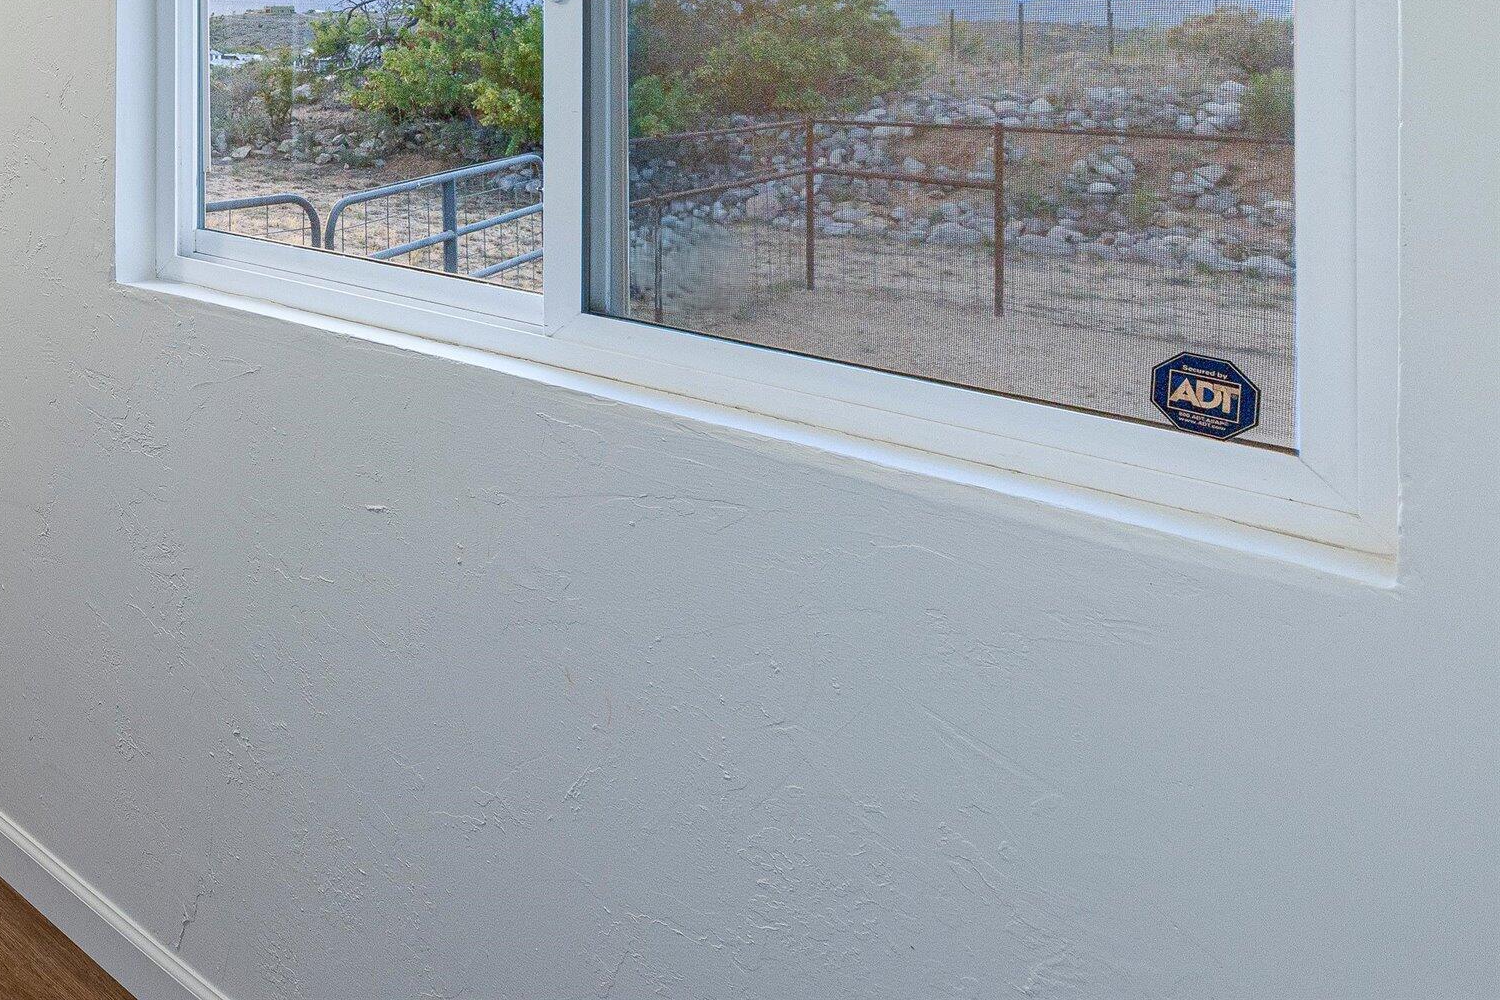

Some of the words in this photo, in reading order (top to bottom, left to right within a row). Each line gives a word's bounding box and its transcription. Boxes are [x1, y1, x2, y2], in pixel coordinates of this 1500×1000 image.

[1182, 364, 1216, 377] Secured
[1216, 371, 1228, 380] by
[1169, 377, 1240, 414] ADT
